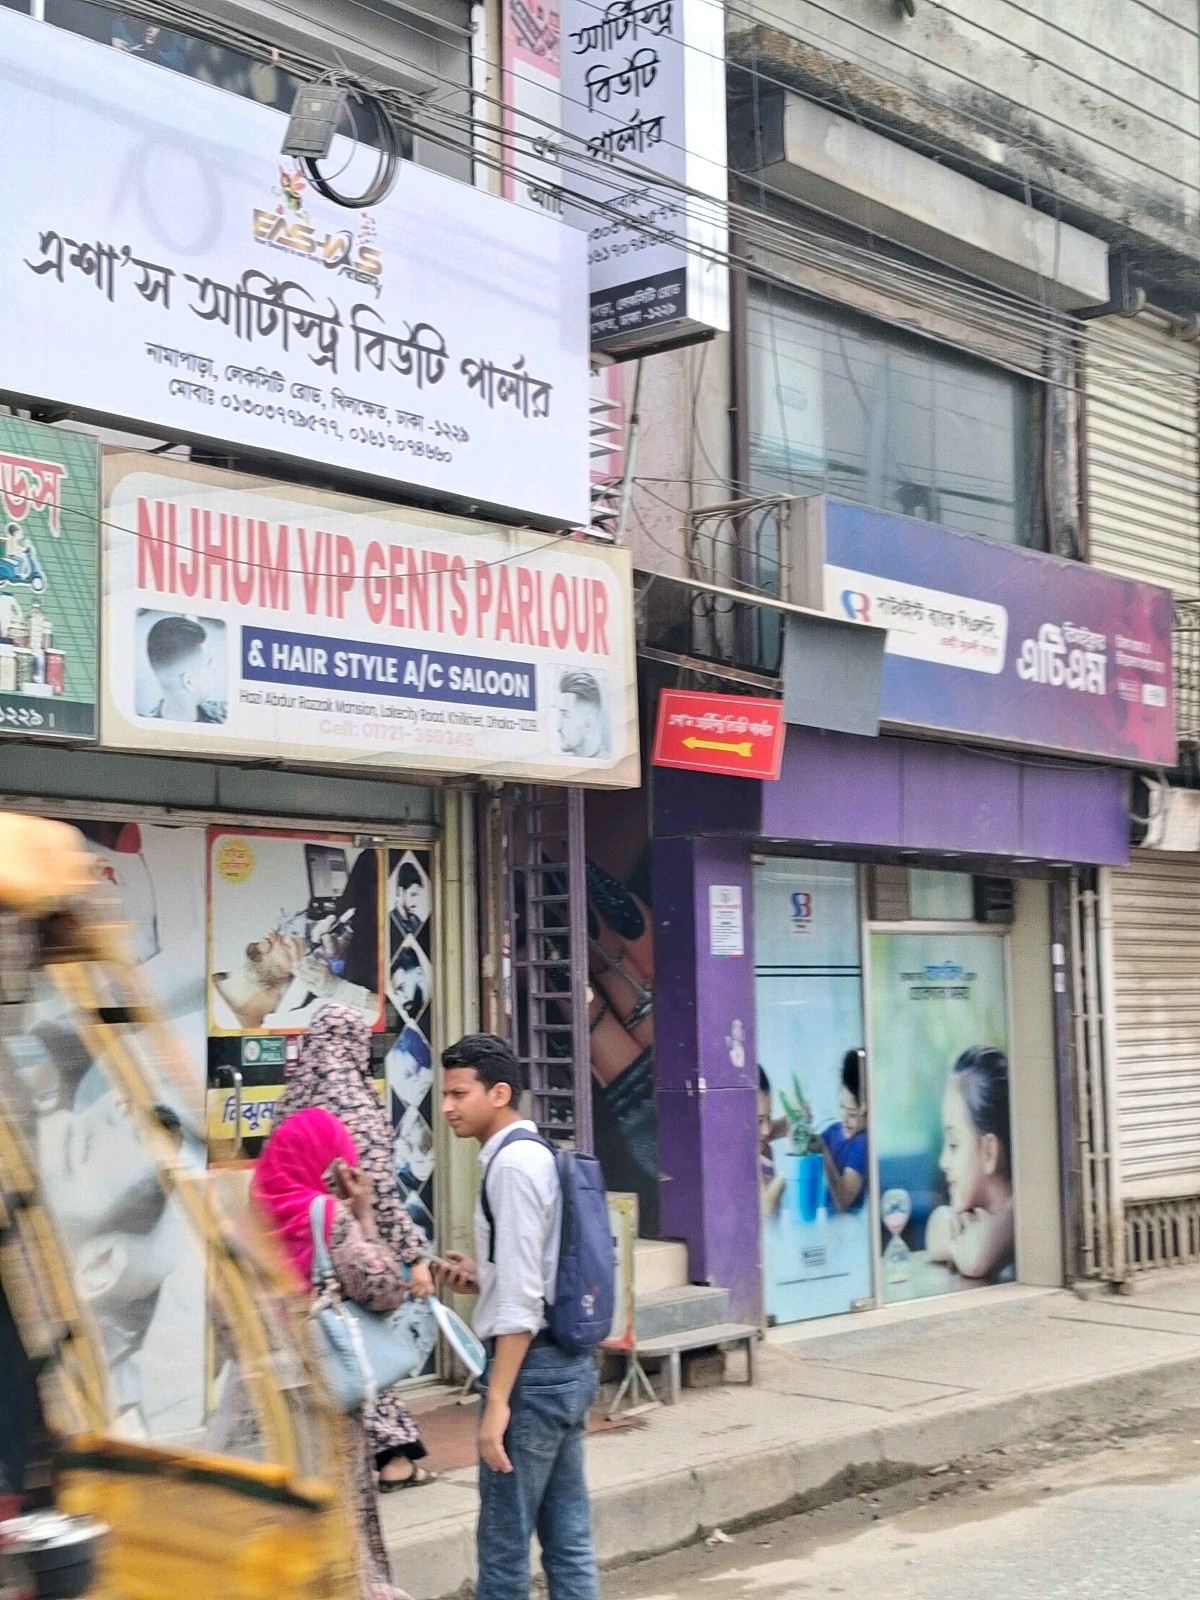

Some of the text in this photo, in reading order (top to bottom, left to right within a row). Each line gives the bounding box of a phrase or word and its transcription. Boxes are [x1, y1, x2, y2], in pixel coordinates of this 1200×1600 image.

[584, 48, 662, 113] বিউটি
[586, 108, 665, 163] পার্লার
[183, 269, 344, 375] আর্টিস্ট্রি
[350, 303, 450, 390] বিউটি
[460, 353, 554, 419] পার্লার
[224, 365, 287, 393] লেকসিটি
[395, 409, 425, 432] ঢাকা
[136, 496, 611, 656] NIJHUM VIP GENTS PARLOUR
[248, 639, 530, 699] & HAIR STYLE A/C SALOON
[1016, 622, 1108, 696] এটিএম
[318, 719, 360, 738] Cell:
